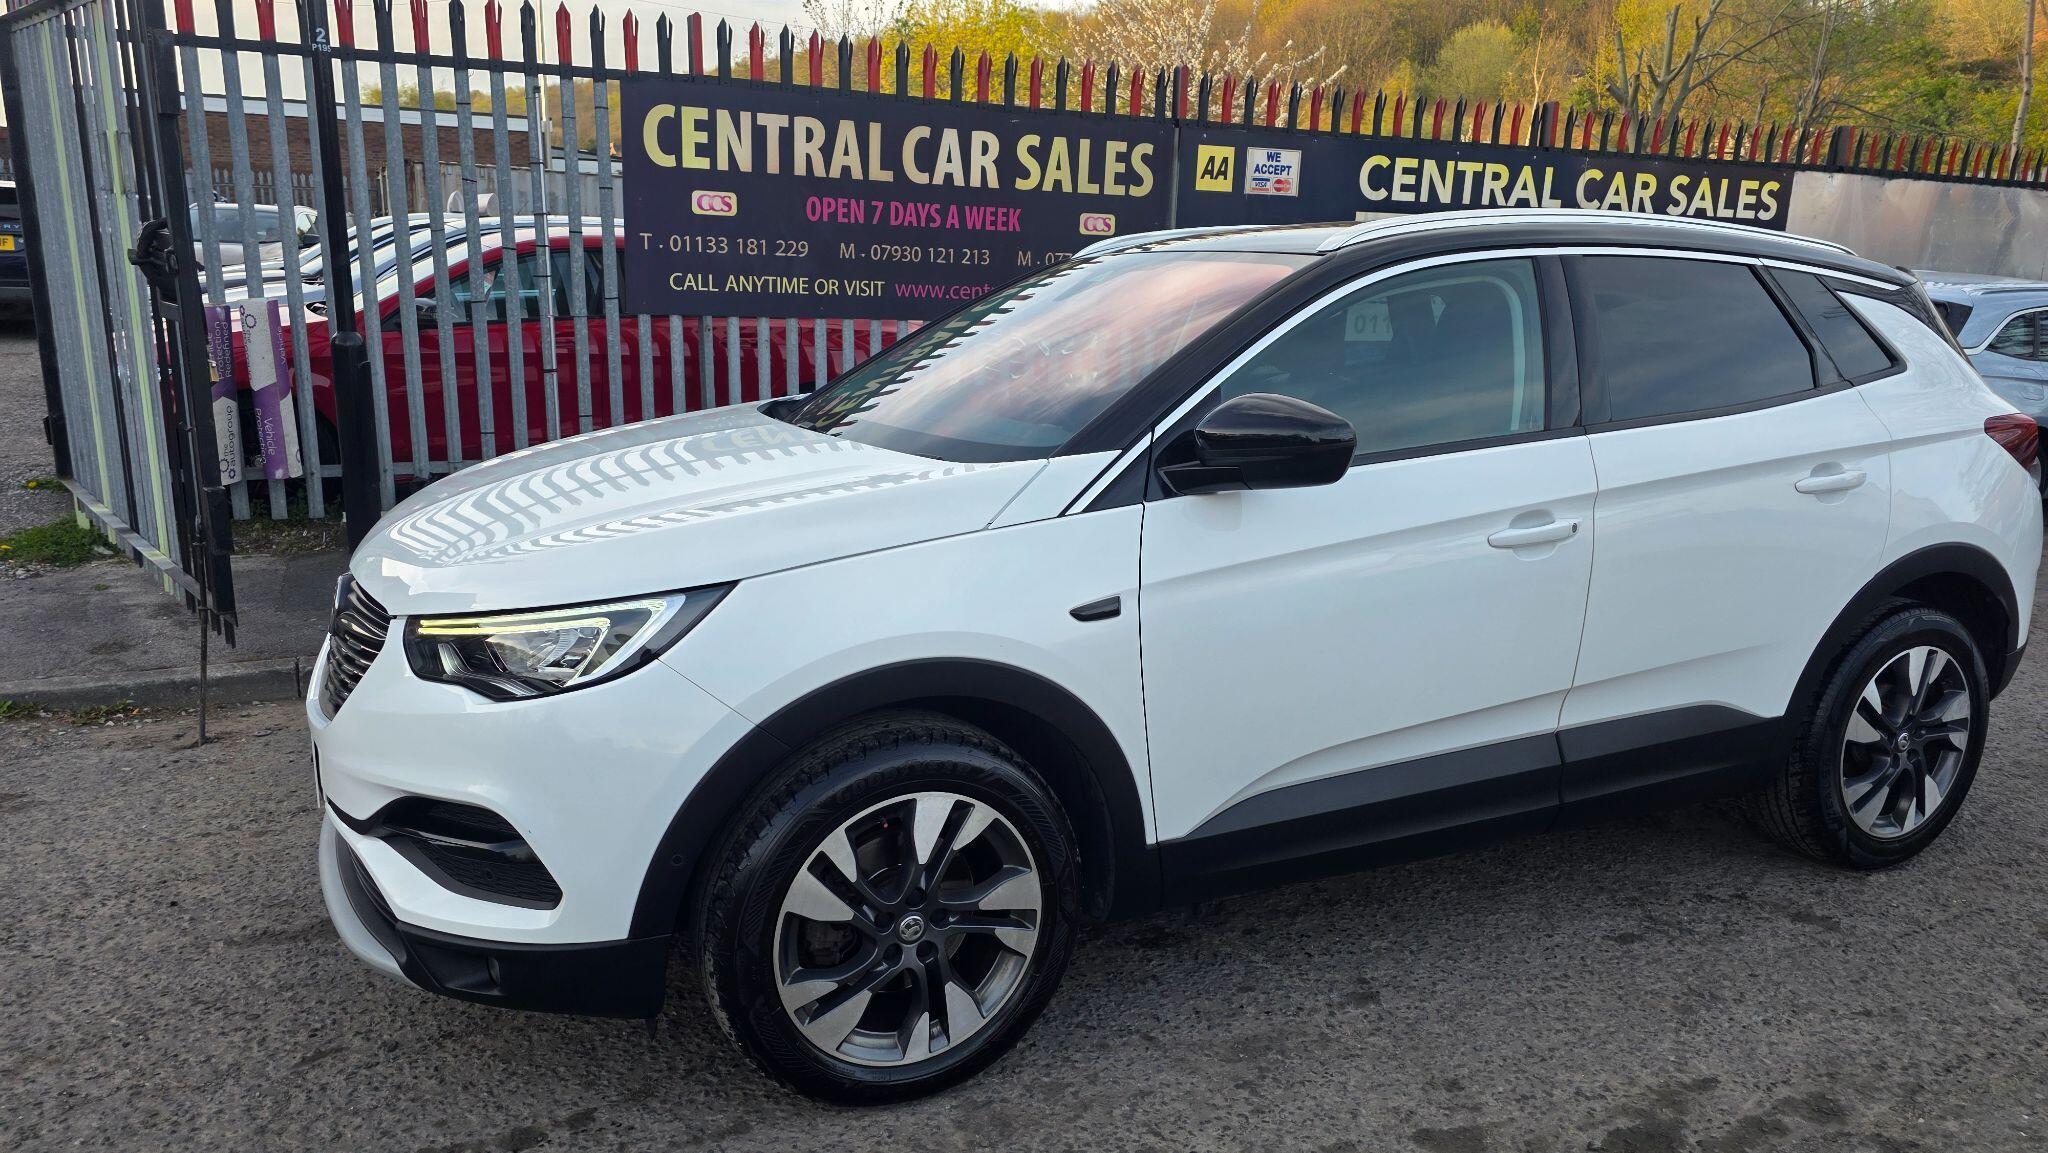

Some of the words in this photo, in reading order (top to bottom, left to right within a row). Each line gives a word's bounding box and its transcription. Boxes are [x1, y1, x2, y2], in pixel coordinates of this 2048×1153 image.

[312, 43, 332, 52] P195
[315, 27, 327, 42] 2
[643, 104, 894, 182] CENTRAL
[902, 125, 1000, 188] CAR
[1015, 134, 1155, 197] SALES
[1266, 151, 1282, 163] WE
[1200, 155, 1229, 180] AA
[1253, 163, 1292, 176] ACCEPT
[1359, 155, 1562, 209] CENTRAL
[1575, 168, 1658, 214] CAR
[1666, 174, 1781, 222] SALES
[806, 196, 865, 225] OPEN
[871, 201, 884, 223] 7
[889, 201, 943, 229] DAYS
[945, 207, 960, 230] A
[965, 206, 1023, 233] WEEK
[669, 235, 728, 254] 01133
[736, 238, 767, 256] 181
[775, 240, 809, 257] 229
[871, 244, 922, 262] 07930
[928, 247, 955, 265] 121
[961, 248, 991, 265] 213
[669, 272, 719, 292] CALL
[725, 274, 809, 295] ANYTIME
[814, 278, 839, 296] OR
[844, 279, 886, 297] VISIT
[895, 283, 994, 299] www.cent
[214, 320, 224, 380] Protection
[221, 320, 232, 378] Redefined
[225, 404, 237, 467] autogroup
[263, 416, 278, 456] Vehicle
